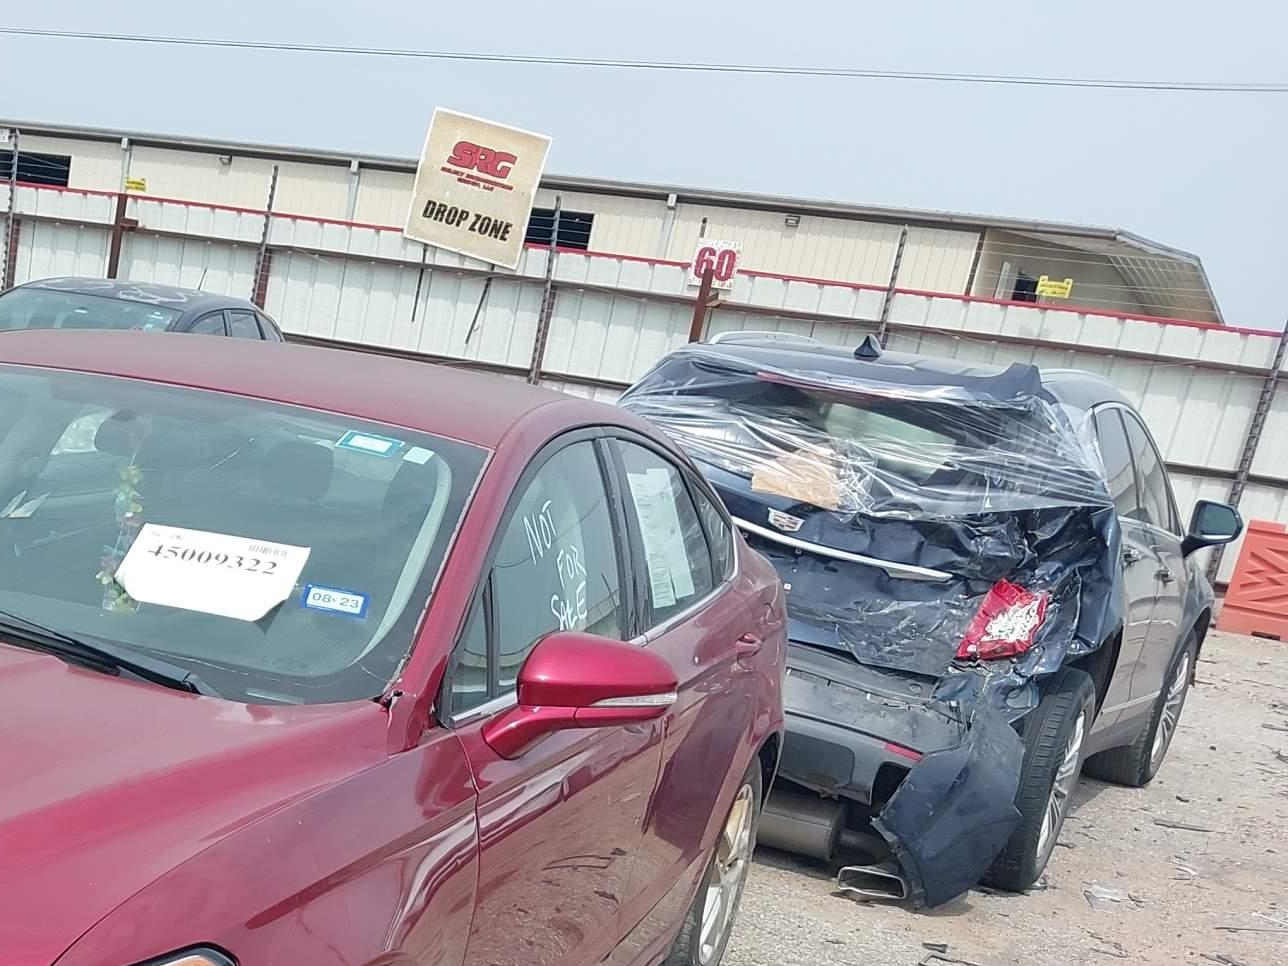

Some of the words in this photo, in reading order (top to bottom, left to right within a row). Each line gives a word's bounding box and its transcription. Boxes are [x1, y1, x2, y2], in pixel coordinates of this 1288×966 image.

[447, 141, 518, 179] SRG
[422, 199, 471, 228] DROP
[468, 213, 513, 242] ZONE
[694, 246, 737, 282] 60
[523, 499, 557, 566] NOT
[148, 544, 278, 575] 45009322
[556, 544, 588, 590] FOR
[550, 580, 588, 631] SALE
